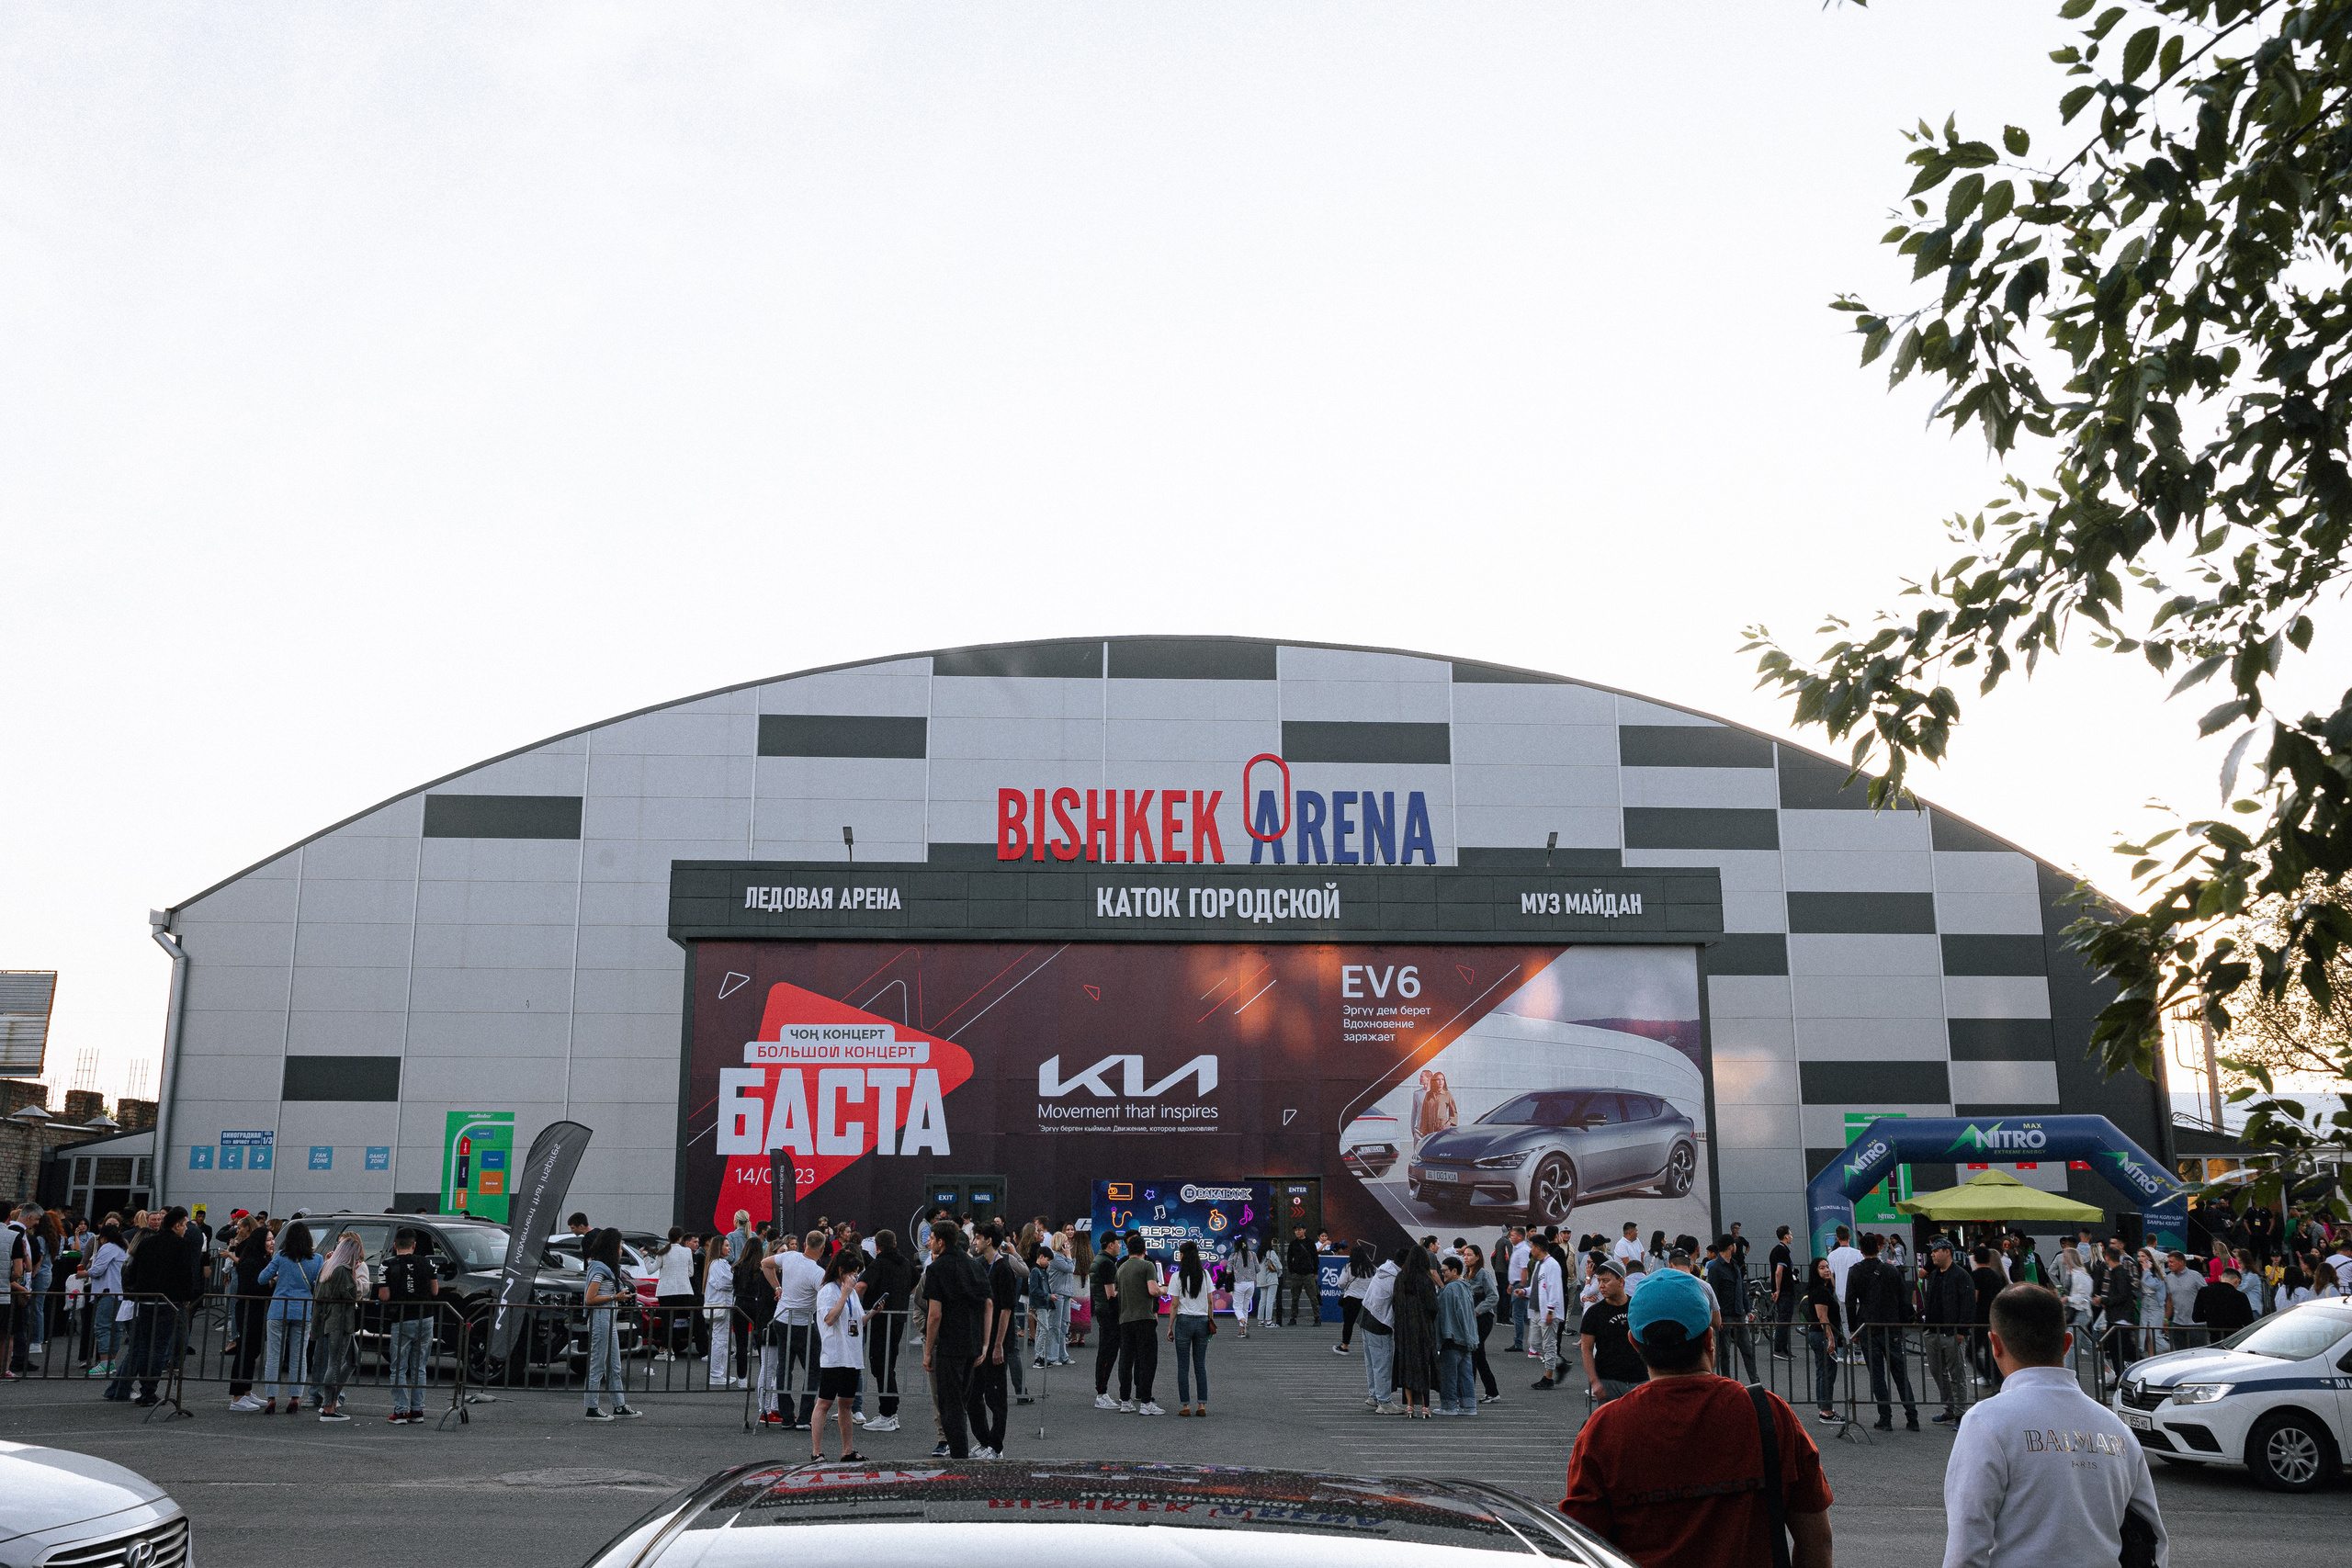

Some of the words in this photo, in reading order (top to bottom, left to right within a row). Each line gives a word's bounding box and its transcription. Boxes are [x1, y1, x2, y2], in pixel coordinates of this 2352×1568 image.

[997, 786, 1225, 863] BISHKEK
[1250, 789, 1437, 864] ARENA
[744, 886, 833, 912] ЛЕДОВАЯ
[840, 887, 901, 909] АРЕНА
[1097, 887, 1181, 918] КАТОК
[1189, 882, 1340, 923] ГОРОДСКОЙ
[1521, 893, 1560, 914] МУЗ
[1565, 888, 1642, 918] МАЙДАН
[1341, 965, 1421, 998] EV6
[1377, 1007, 1397, 1016] дем
[1400, 1005, 1431, 1016] берет
[1343, 1019, 1415, 1029] Вдохновение
[790, 1029, 820, 1042] ЧОҢ
[823, 1029, 885, 1041] КОНЦЕРТ
[1343, 1032, 1396, 1043] заряжает
[757, 1044, 840, 1058] БОЛЬШОЙ
[845, 1045, 917, 1059] КОНЦЕРТ
[1038, 1054, 1218, 1098] KIA
[716, 1067, 951, 1156] БАСТА
[1038, 1103, 1121, 1119] Movement
[1125, 1103, 1156, 1119] that
[1160, 1103, 1218, 1122] inspires
[263, 1136, 273, 1145] 1/3
[1975, 1129, 2047, 1148] NITRO
[1849, 1142, 1887, 1175] NITRO
[2118, 1156, 2159, 1194] NITRO
[1197, 1189, 1250, 1199] BAKAIBANK
[1138, 1225, 1187, 1237] ВЕРЮ
[1321, 1267, 1340, 1287] 25
[2023, 1429, 2126, 1459] BALMAIN
[2071, 1460, 2098, 1470] PARIS
